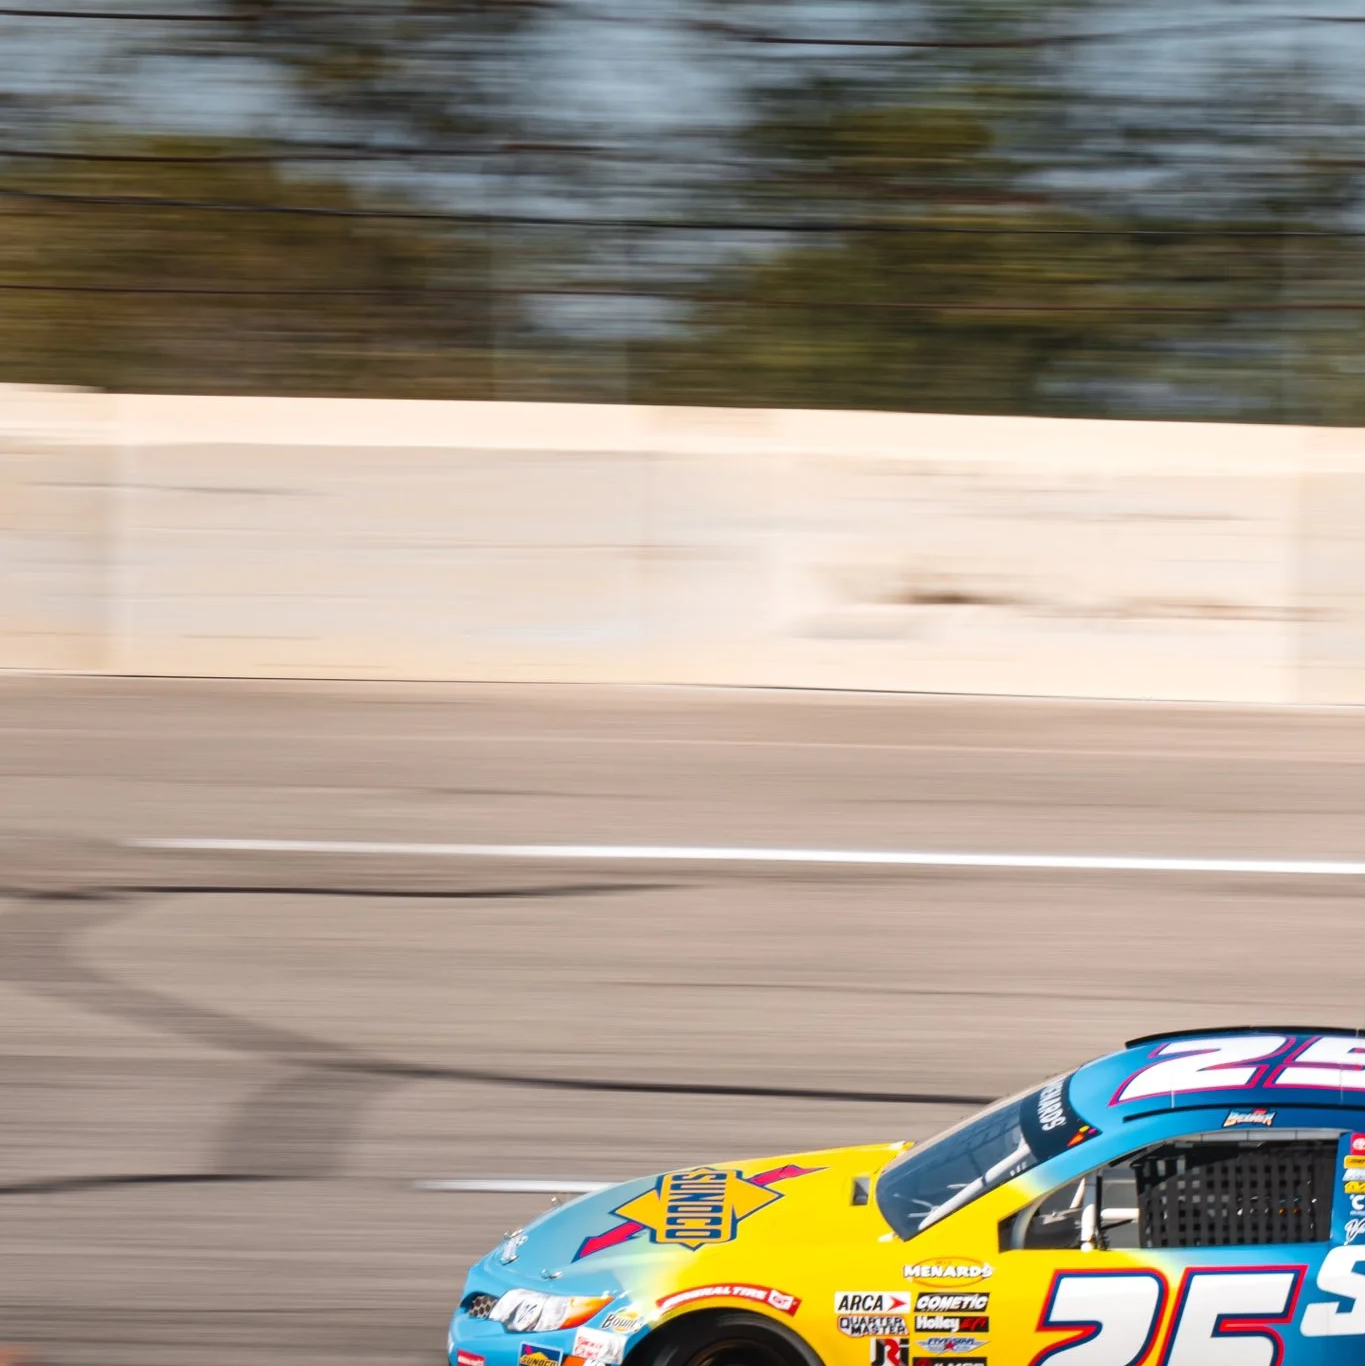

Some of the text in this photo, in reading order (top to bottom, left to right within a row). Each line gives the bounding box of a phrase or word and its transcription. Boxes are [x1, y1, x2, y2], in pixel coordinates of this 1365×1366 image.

[665, 1172, 728, 1239] SUNOCO
[904, 1265, 993, 1278] MENARDS
[660, 1286, 730, 1312] NERAL
[838, 1295, 883, 1311] ARCA
[916, 1294, 988, 1310] COMETIC
[840, 1317, 902, 1328] QUARTER
[916, 1316, 960, 1331] Holley
[851, 1326, 906, 1335] MASTER
